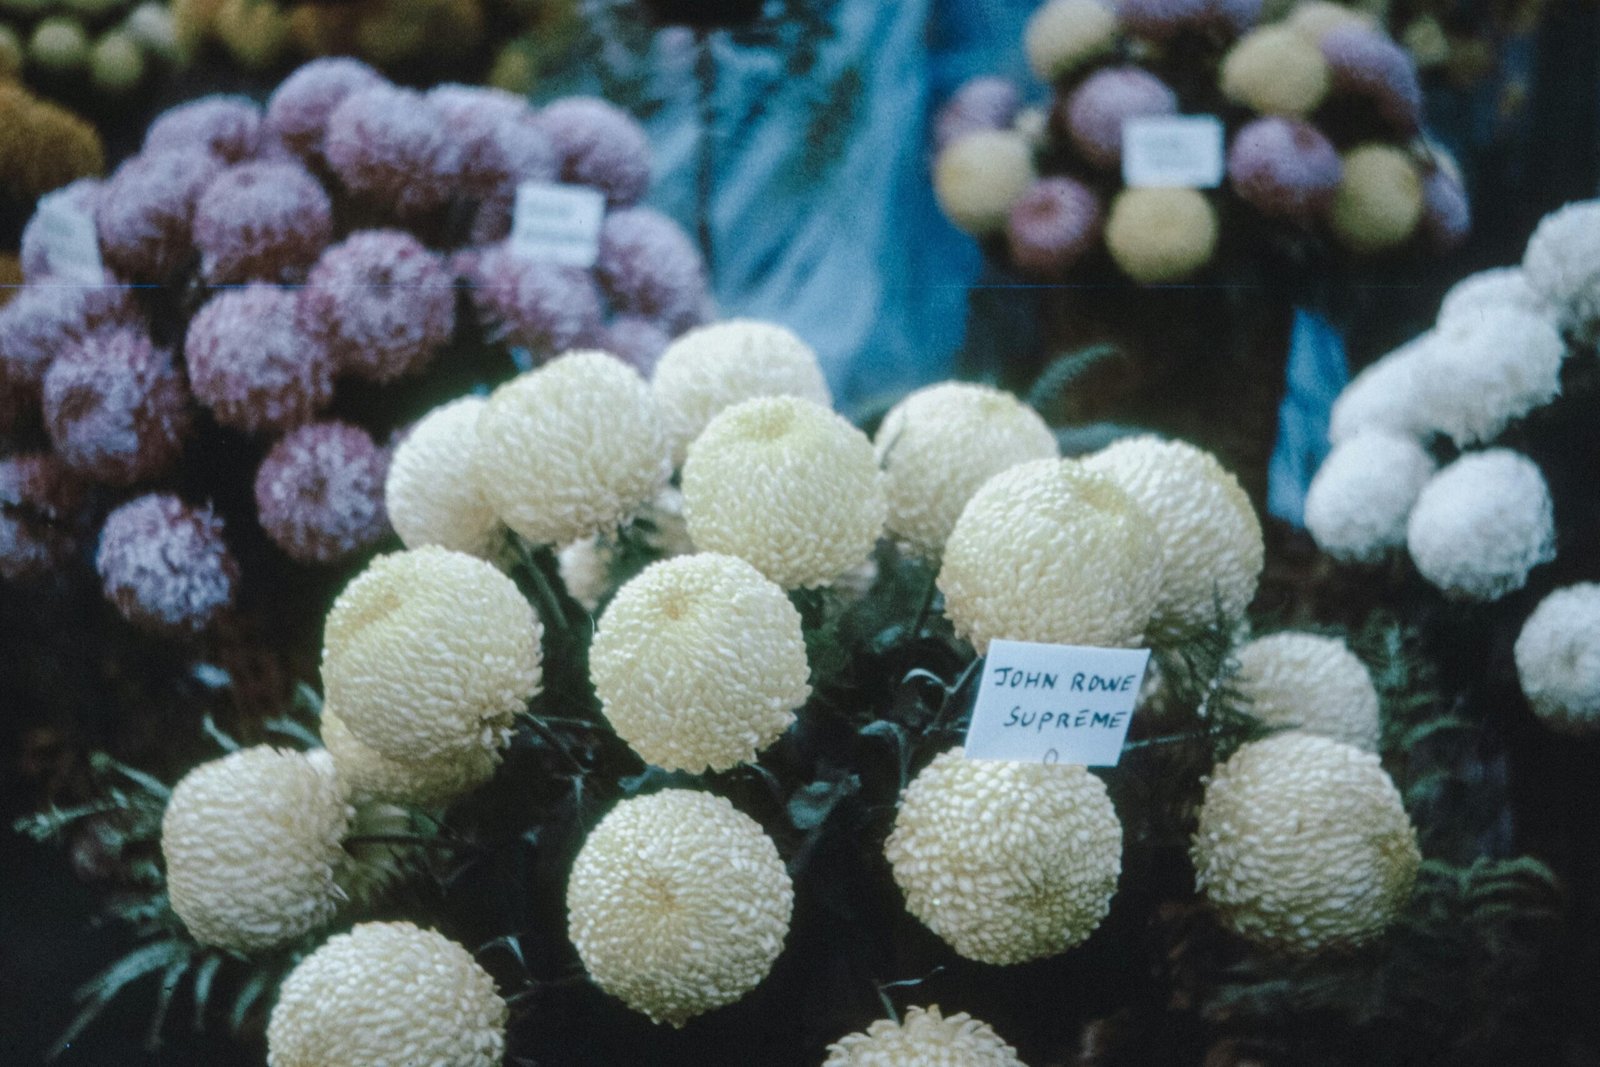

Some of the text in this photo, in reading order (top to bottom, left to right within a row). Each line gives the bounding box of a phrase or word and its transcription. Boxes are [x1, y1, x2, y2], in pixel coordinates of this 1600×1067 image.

[994, 667, 1136, 692] JOHN ROWE
[1003, 706, 1127, 733] SUPREME
